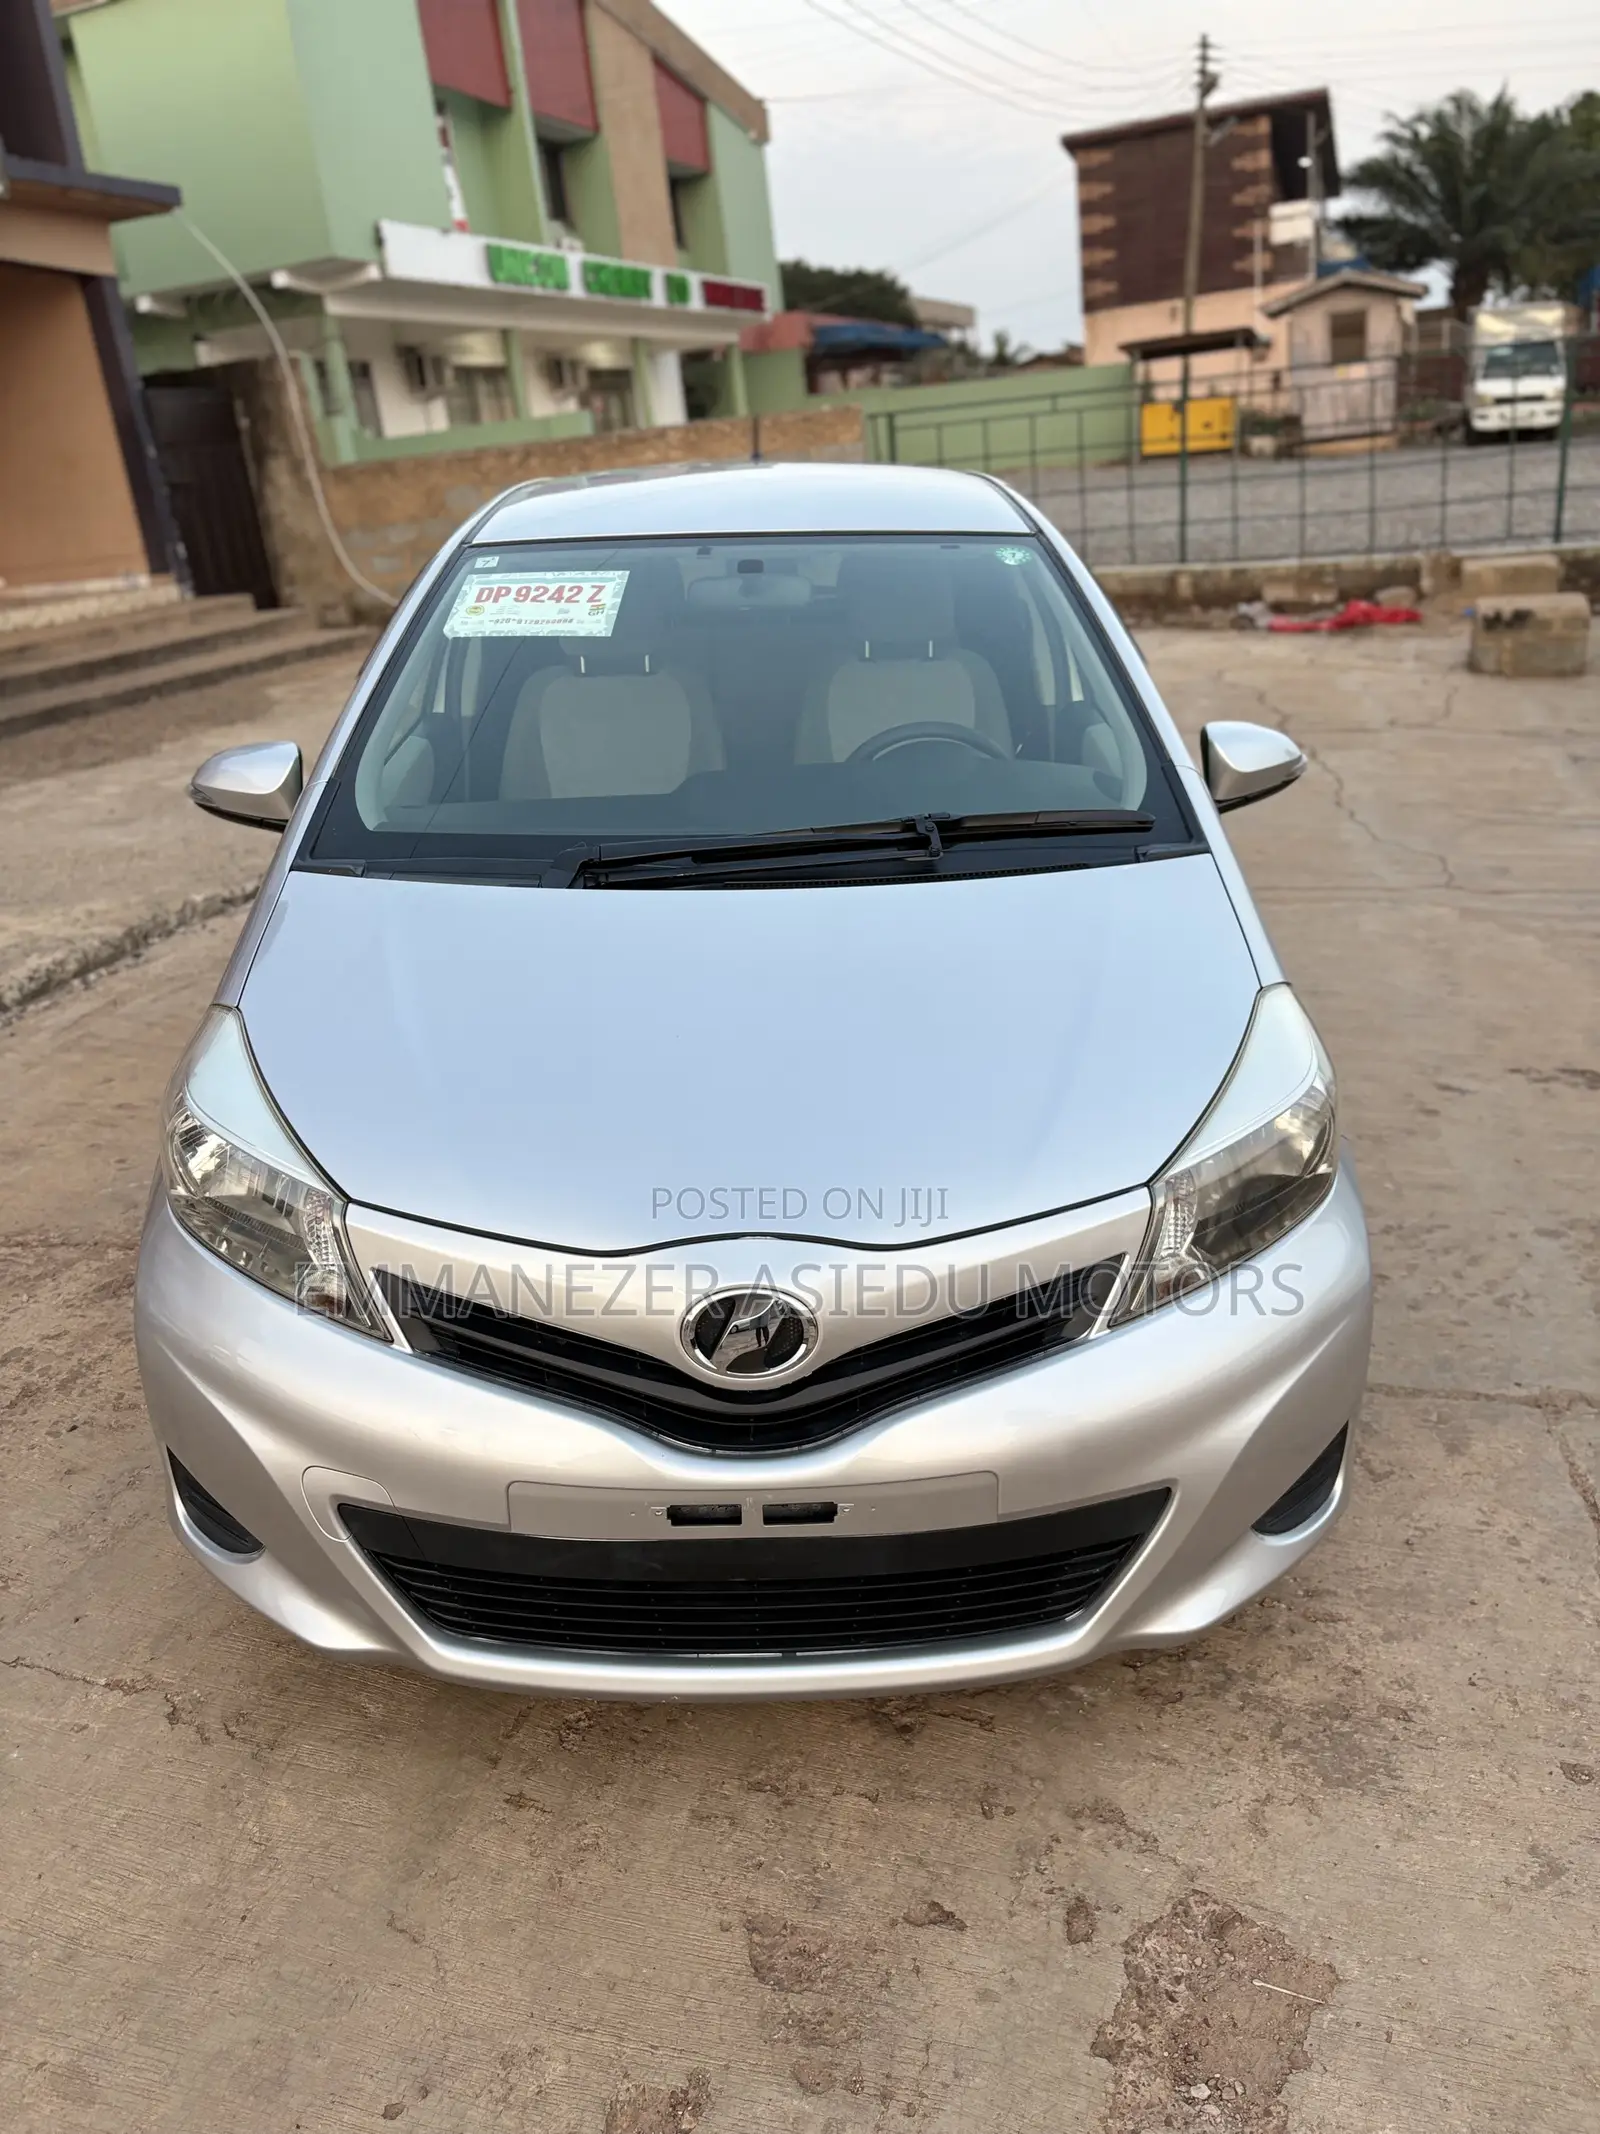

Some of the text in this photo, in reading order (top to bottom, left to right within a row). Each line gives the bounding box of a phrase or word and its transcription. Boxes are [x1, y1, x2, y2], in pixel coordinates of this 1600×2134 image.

[474, 585, 606, 604] DP 9242 Z
